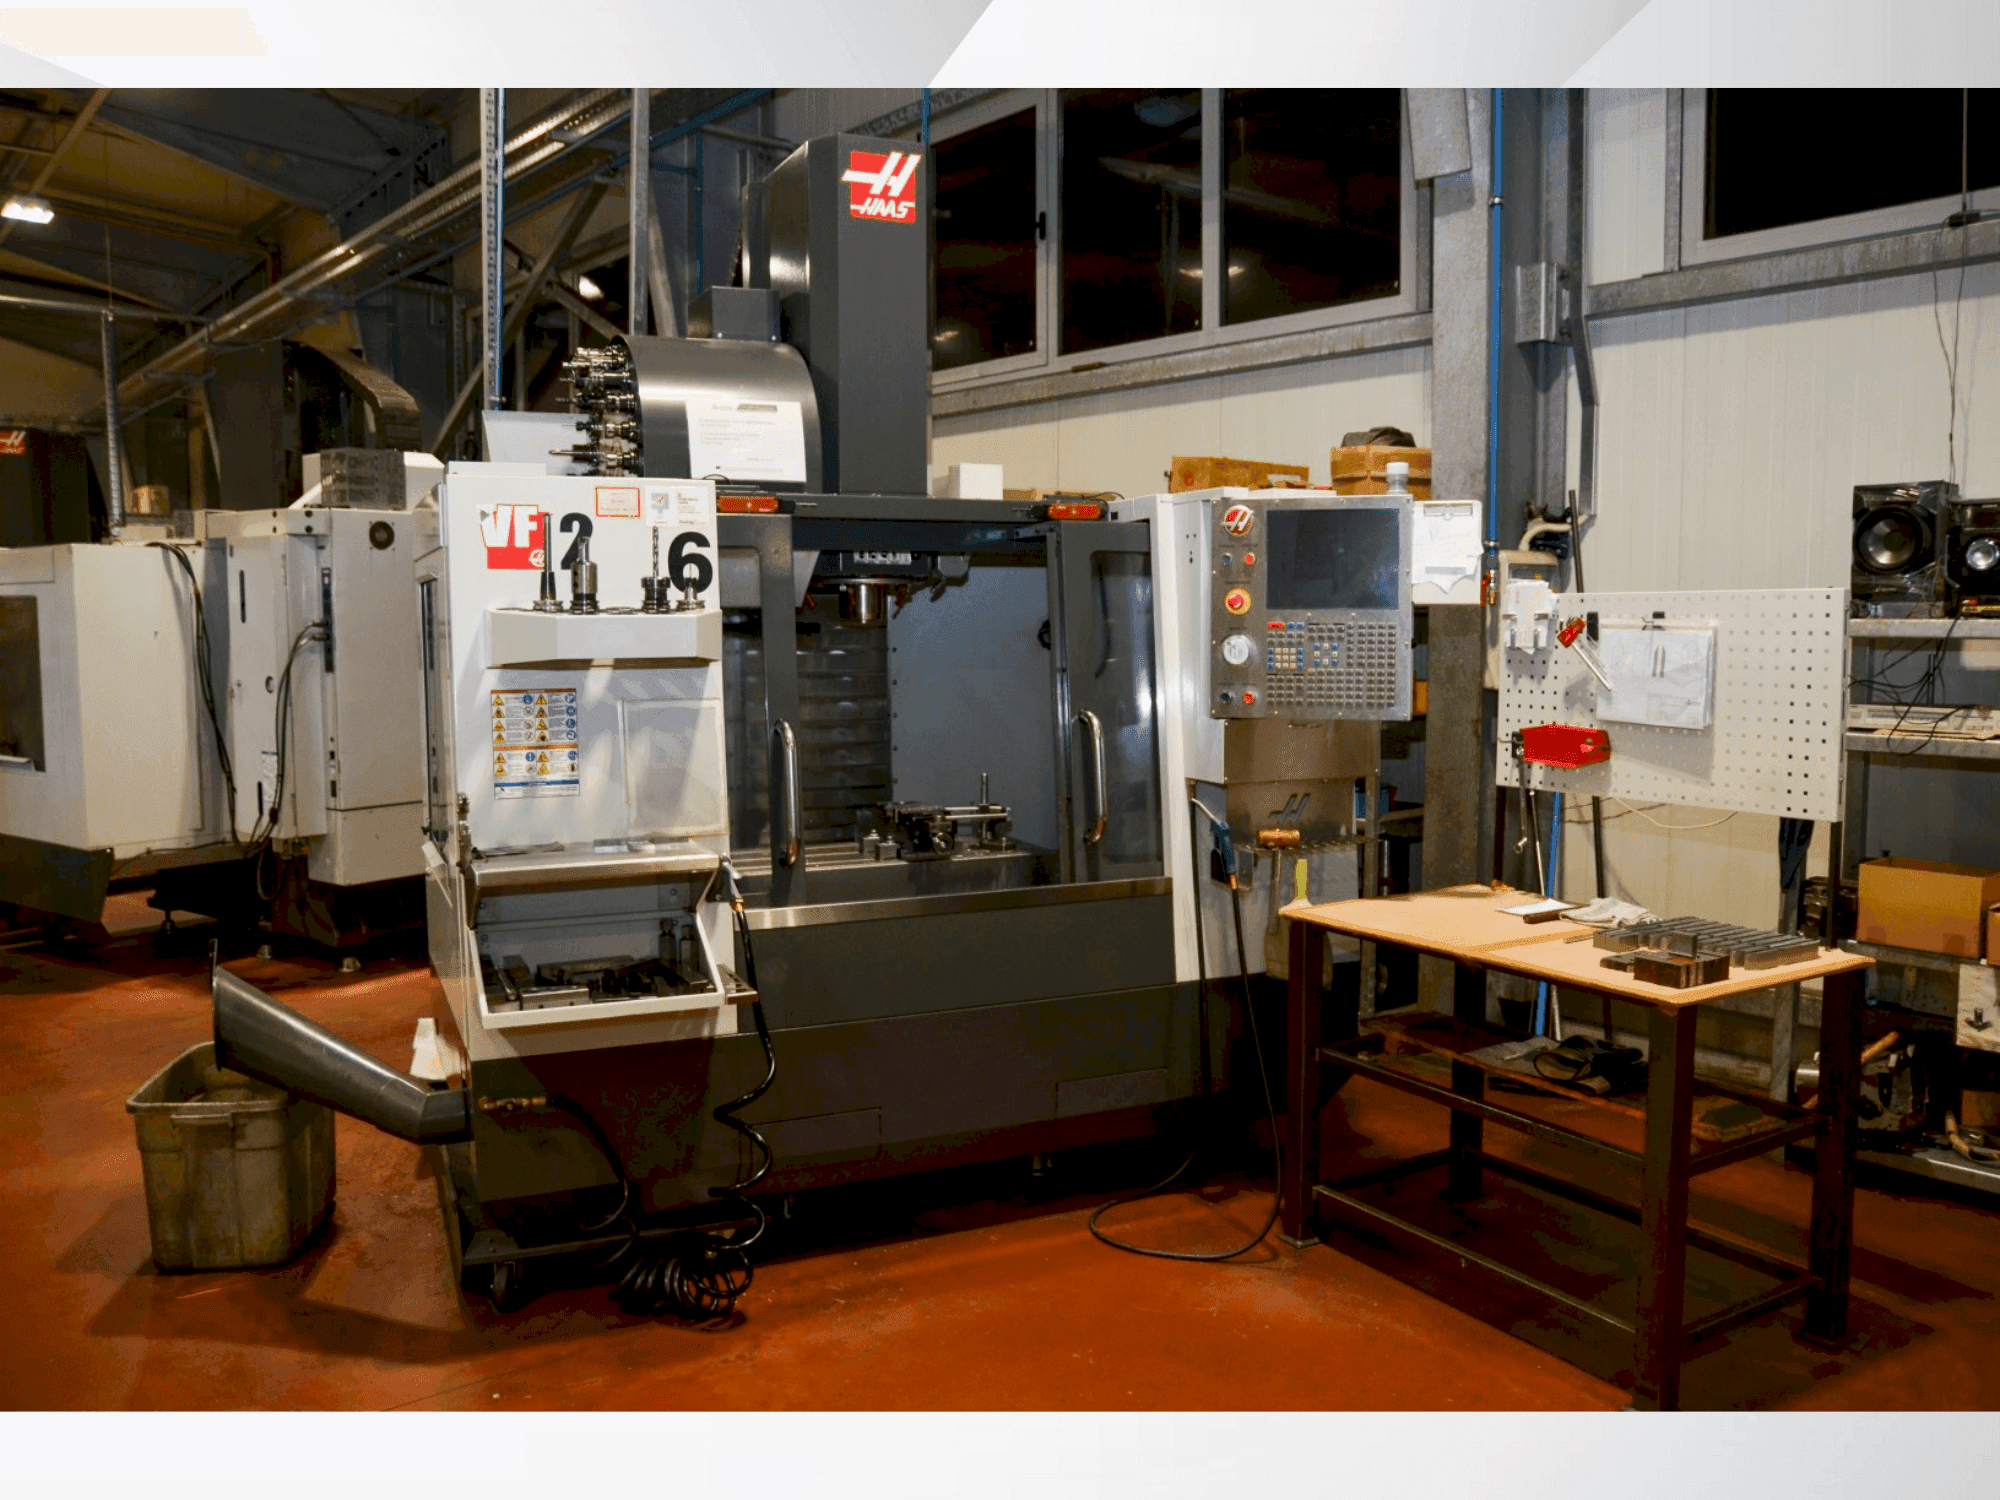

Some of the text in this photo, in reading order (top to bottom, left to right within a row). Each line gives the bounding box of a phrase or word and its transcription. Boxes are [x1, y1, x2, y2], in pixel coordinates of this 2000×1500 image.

[849, 197, 916, 218] HAAS
[478, 503, 593, 570] VF 2
[667, 531, 713, 594] 6
